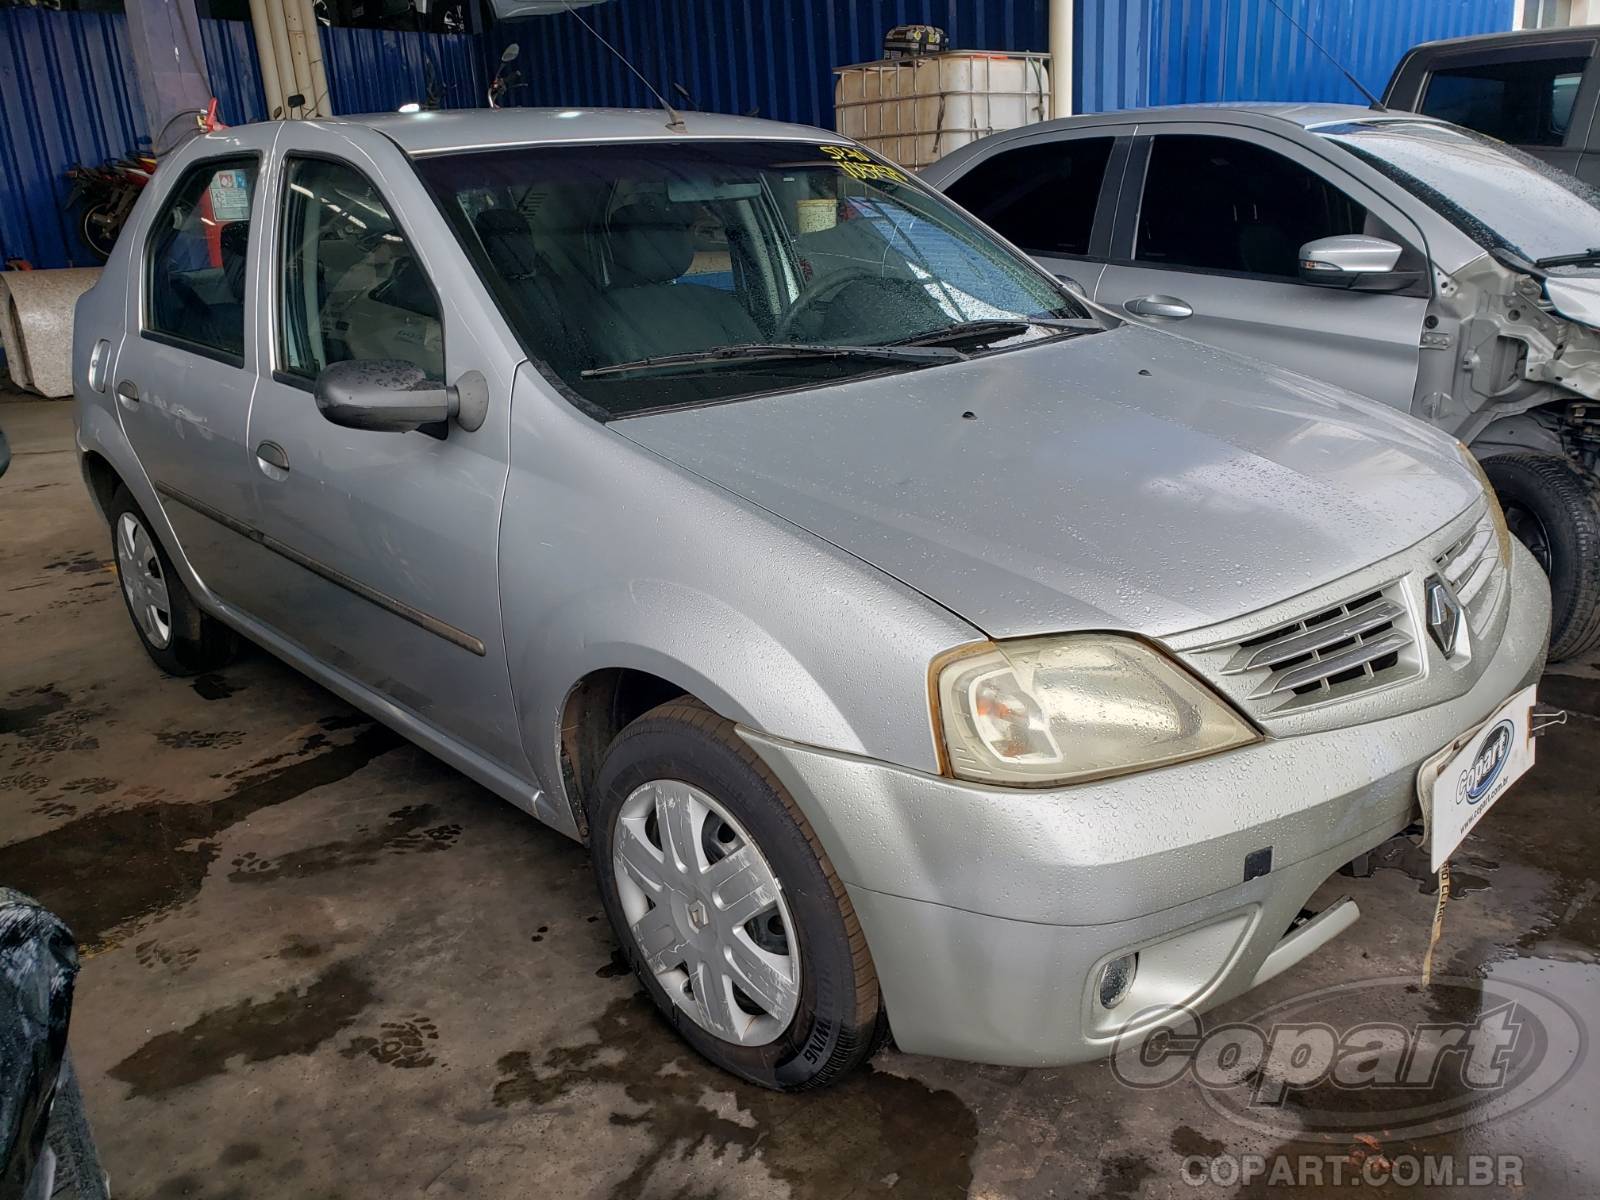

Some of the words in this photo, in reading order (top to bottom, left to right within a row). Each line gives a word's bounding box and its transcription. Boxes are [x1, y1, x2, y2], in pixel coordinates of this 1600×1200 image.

[1456, 725, 1508, 805] Copart
[1460, 775, 1509, 834] www.copart.com.br
[803, 1018, 832, 1064] WING
